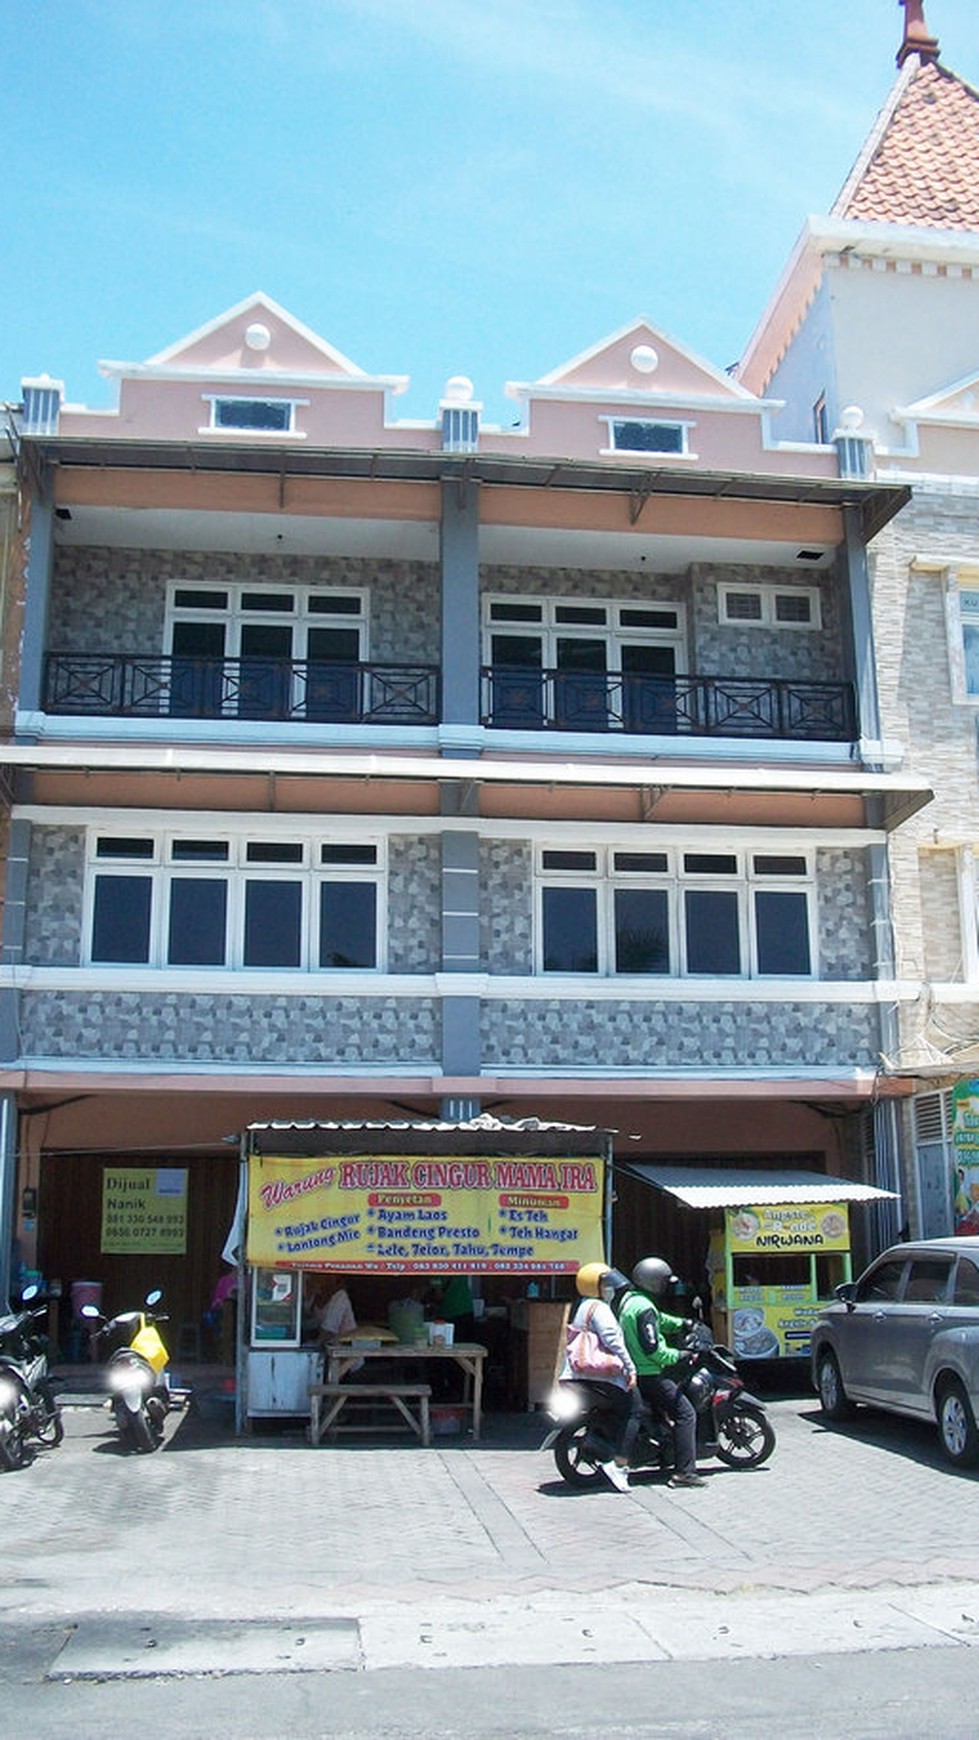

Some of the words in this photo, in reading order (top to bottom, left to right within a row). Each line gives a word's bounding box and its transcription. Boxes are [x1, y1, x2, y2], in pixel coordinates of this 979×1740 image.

[107, 1178, 150, 1193] Dijual
[259, 1167, 337, 1211] Warung
[338, 1161, 411, 1189] RUJAK
[411, 1161, 493, 1190] CINGUR
[493, 1162, 559, 1191] MAMA
[560, 1163, 598, 1193] IRA
[107, 1198, 146, 1210] Nanik
[377, 1208, 415, 1223] Ayam
[418, 1209, 447, 1221] Laos
[509, 1209, 524, 1222] Es
[525, 1210, 548, 1223] Teh
[284, 1221, 319, 1238] Rujak
[320, 1213, 360, 1230] Cingur
[287, 1234, 336, 1253] Lontong
[337, 1229, 361, 1243] Mie
[377, 1226, 435, 1241] Bandeng
[438, 1226, 480, 1239] Presto
[509, 1225, 532, 1239] Teh
[535, 1227, 579, 1243] Hangat
[756, 1234, 824, 1249] NIRWANA
[452, 1243, 489, 1257] Tahu,
[490, 1243, 534, 1258] Tempe
